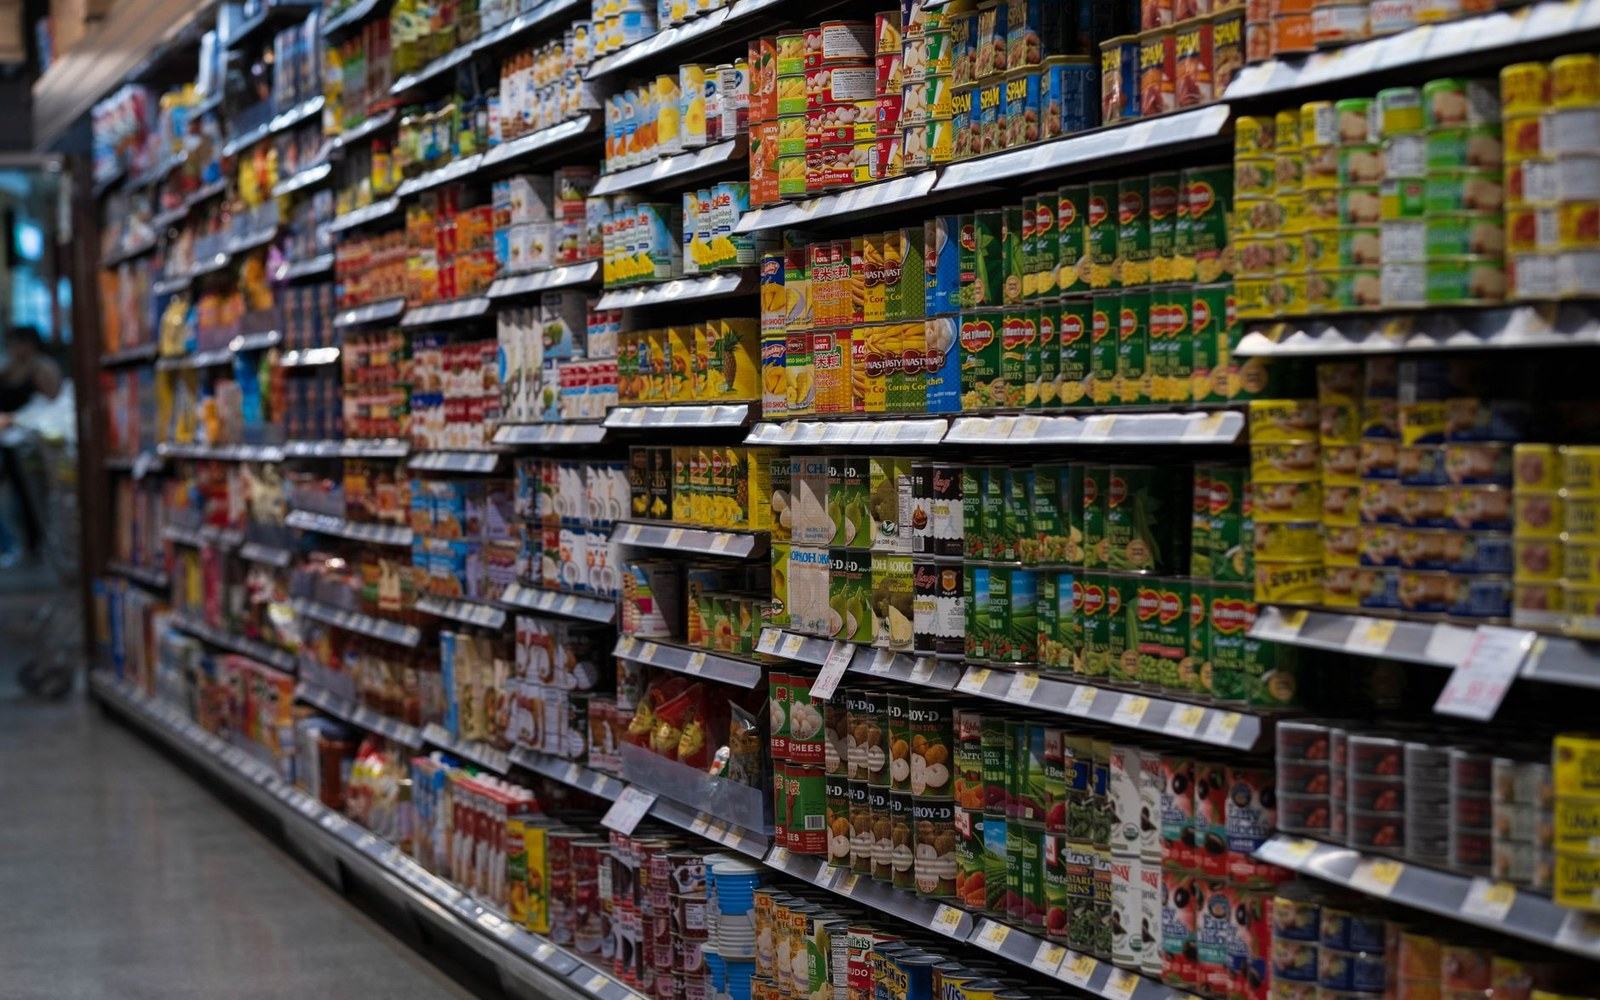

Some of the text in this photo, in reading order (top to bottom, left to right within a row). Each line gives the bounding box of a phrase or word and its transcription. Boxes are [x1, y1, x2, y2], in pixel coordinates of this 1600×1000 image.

[952, 20, 970, 42] SPAM
[1215, 18, 1240, 46] SPAM
[1141, 42, 1164, 69] SPAM
[1176, 30, 1200, 57] SPAM
[1101, 48, 1121, 73] SPAM
[981, 87, 1000, 111] SPAM
[1007, 78, 1027, 102] SPAM
[952, 93, 971, 116] SPAM
